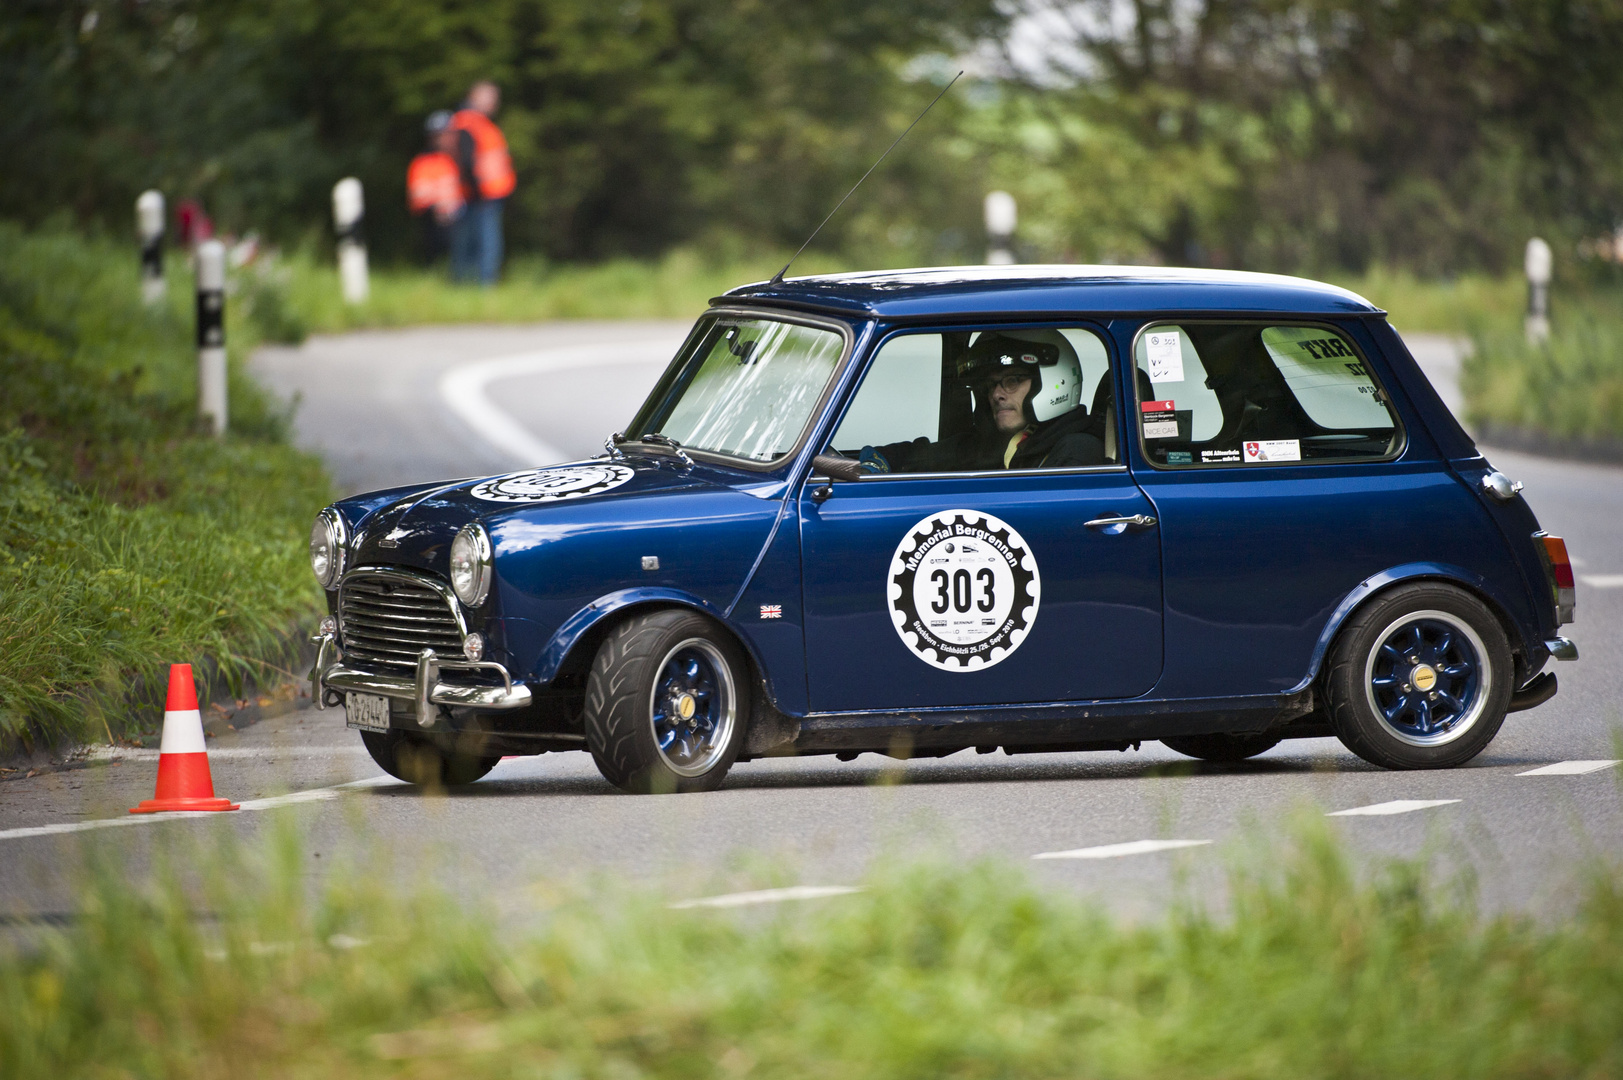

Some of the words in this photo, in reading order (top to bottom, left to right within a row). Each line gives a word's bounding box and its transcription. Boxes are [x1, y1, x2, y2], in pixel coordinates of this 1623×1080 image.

[1145, 428, 1161, 436] NICE
[1161, 426, 1177, 435] CAR
[513, 474, 583, 488] 303
[905, 525, 954, 572] Memorial
[954, 524, 1019, 568] Bergrennen
[931, 567, 995, 614] 303
[913, 620, 937, 647] Steckborn
[940, 643, 969, 655] Eichhölzli
[989, 633, 1004, 646] Sept.
[1002, 618, 1015, 634] 2010
